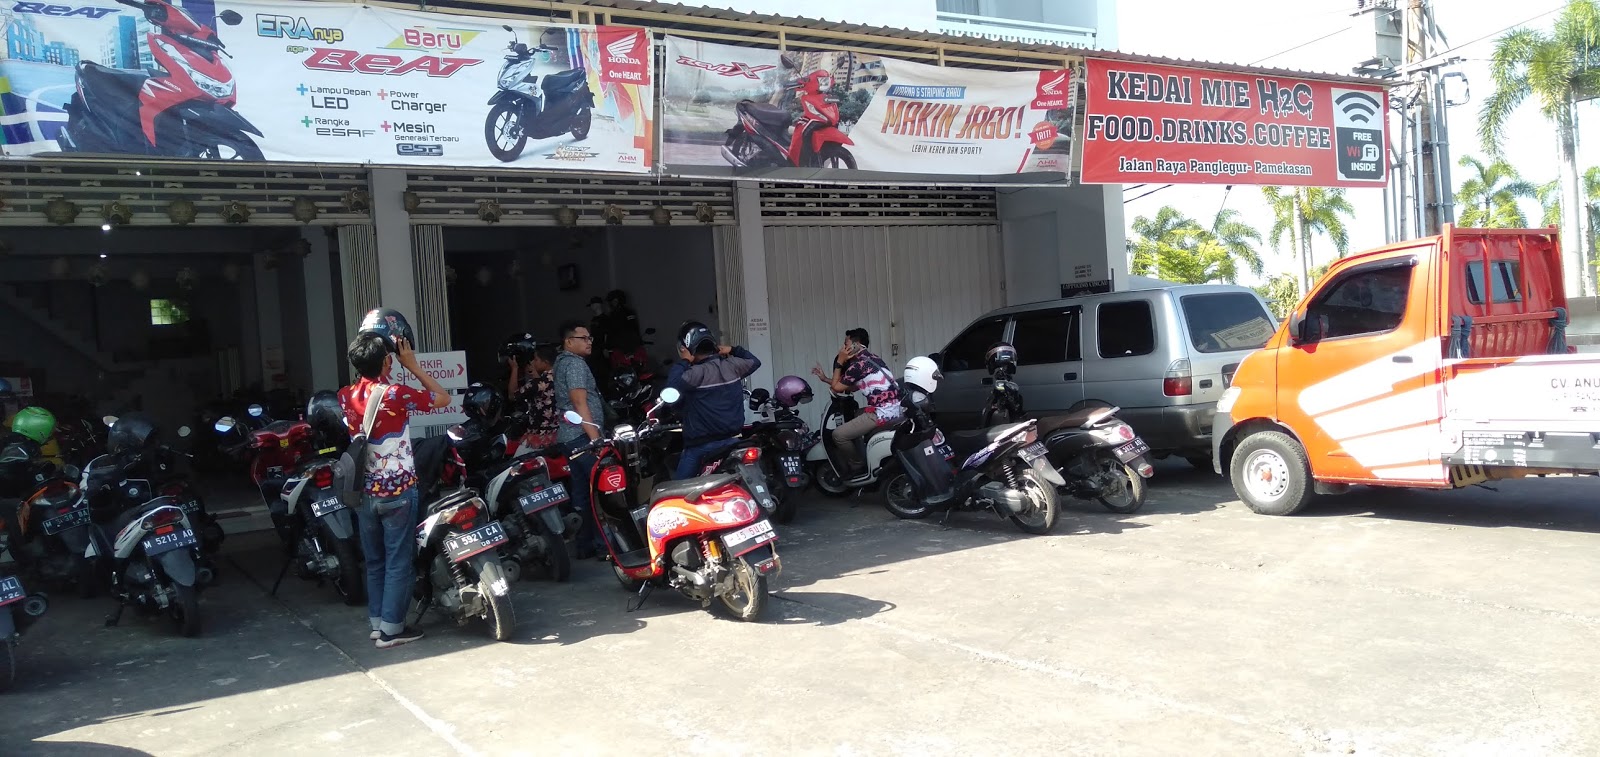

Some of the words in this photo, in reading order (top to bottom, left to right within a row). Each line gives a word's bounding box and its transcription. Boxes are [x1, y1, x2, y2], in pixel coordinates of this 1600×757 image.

[403, 28, 462, 49] Baru
[607, 56, 641, 65] HONDA
[609, 70, 622, 79] One
[310, 85, 342, 96] Lampu
[342, 87, 372, 97] Depan
[390, 90, 419, 99] Power
[893, 86, 916, 96] WARNA
[920, 87, 945, 98] STRIPING
[945, 87, 961, 98] BARU
[1107, 69, 1192, 105] KEDAI
[1201, 77, 1251, 109] MIE
[1256, 77, 1313, 122] H2C
[311, 95, 349, 110] LED
[391, 99, 447, 114] Charger
[314, 117, 350, 127] Rangka
[881, 100, 962, 139] MAKIN
[955, 105, 1026, 139] JAGO!
[393, 122, 435, 134] Mesin
[1086, 113, 1331, 150] FOOD.DRINKS.COFFEE
[394, 134, 429, 142] Generasi
[429, 135, 459, 143] Terbaru
[1036, 130, 1051, 141] IRIT!
[1352, 132, 1373, 142] FREE
[912, 144, 927, 153] LEBIH
[928, 145, 946, 154] KEREN
[947, 146, 959, 154] DAN
[959, 146, 982, 155] SPORTY
[1119, 156, 1153, 173] Jalan
[1156, 157, 1186, 175] Raya
[1255, 161, 1312, 176] Pamekasan
[1350, 162, 1377, 172] INSIDE
[420, 359, 443, 370] RKIR
[396, 369, 455, 382] SHOROOM
[407, 406, 457, 418] ENJUALAN
[521, 498, 529, 506] M
[143, 540, 152, 549] M
[155, 533, 178, 545] 5213
[449, 540, 459, 550] M
[461, 531, 483, 546] 5921
[485, 526, 498, 536] CA
[2, 581, 16, 592] AL
